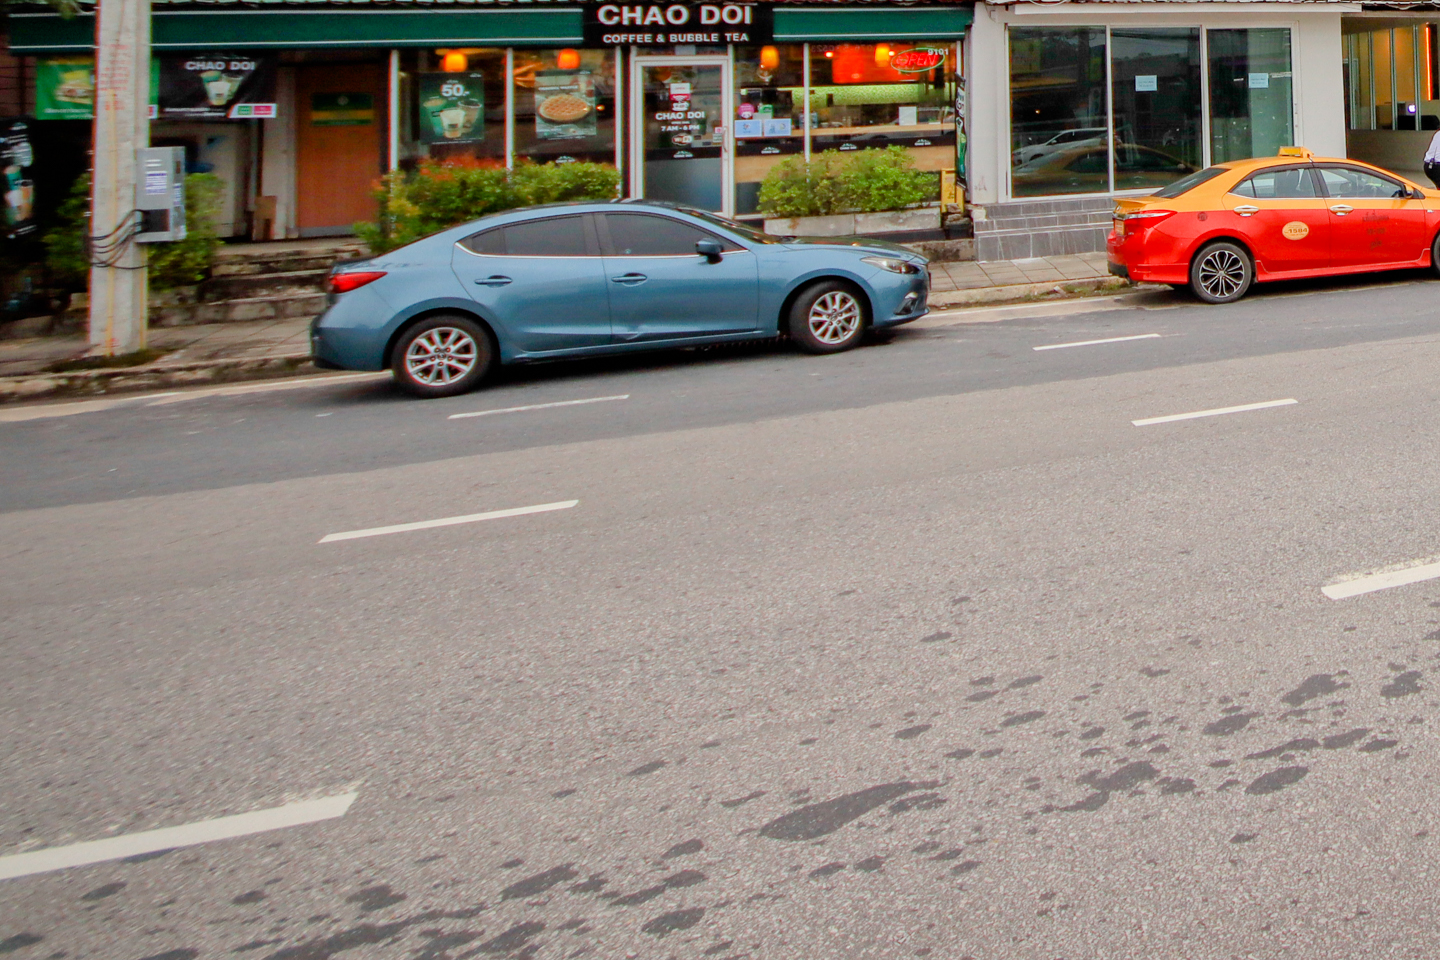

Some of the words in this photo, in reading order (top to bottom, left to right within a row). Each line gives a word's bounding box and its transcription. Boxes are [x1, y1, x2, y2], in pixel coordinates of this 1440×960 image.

[597, 4, 689, 26] CHAO
[700, 5, 753, 25] DOI
[602, 33, 653, 43] COFFEE
[656, 34, 666, 43] &
[669, 33, 719, 43] BUBBLE
[724, 32, 750, 42] TEA
[896, 53, 936, 66] OPEN
[185, 61, 226, 71] CHAO
[230, 61, 256, 70] DOI
[655, 112, 685, 120] CHAO
[687, 111, 706, 119] DOI
